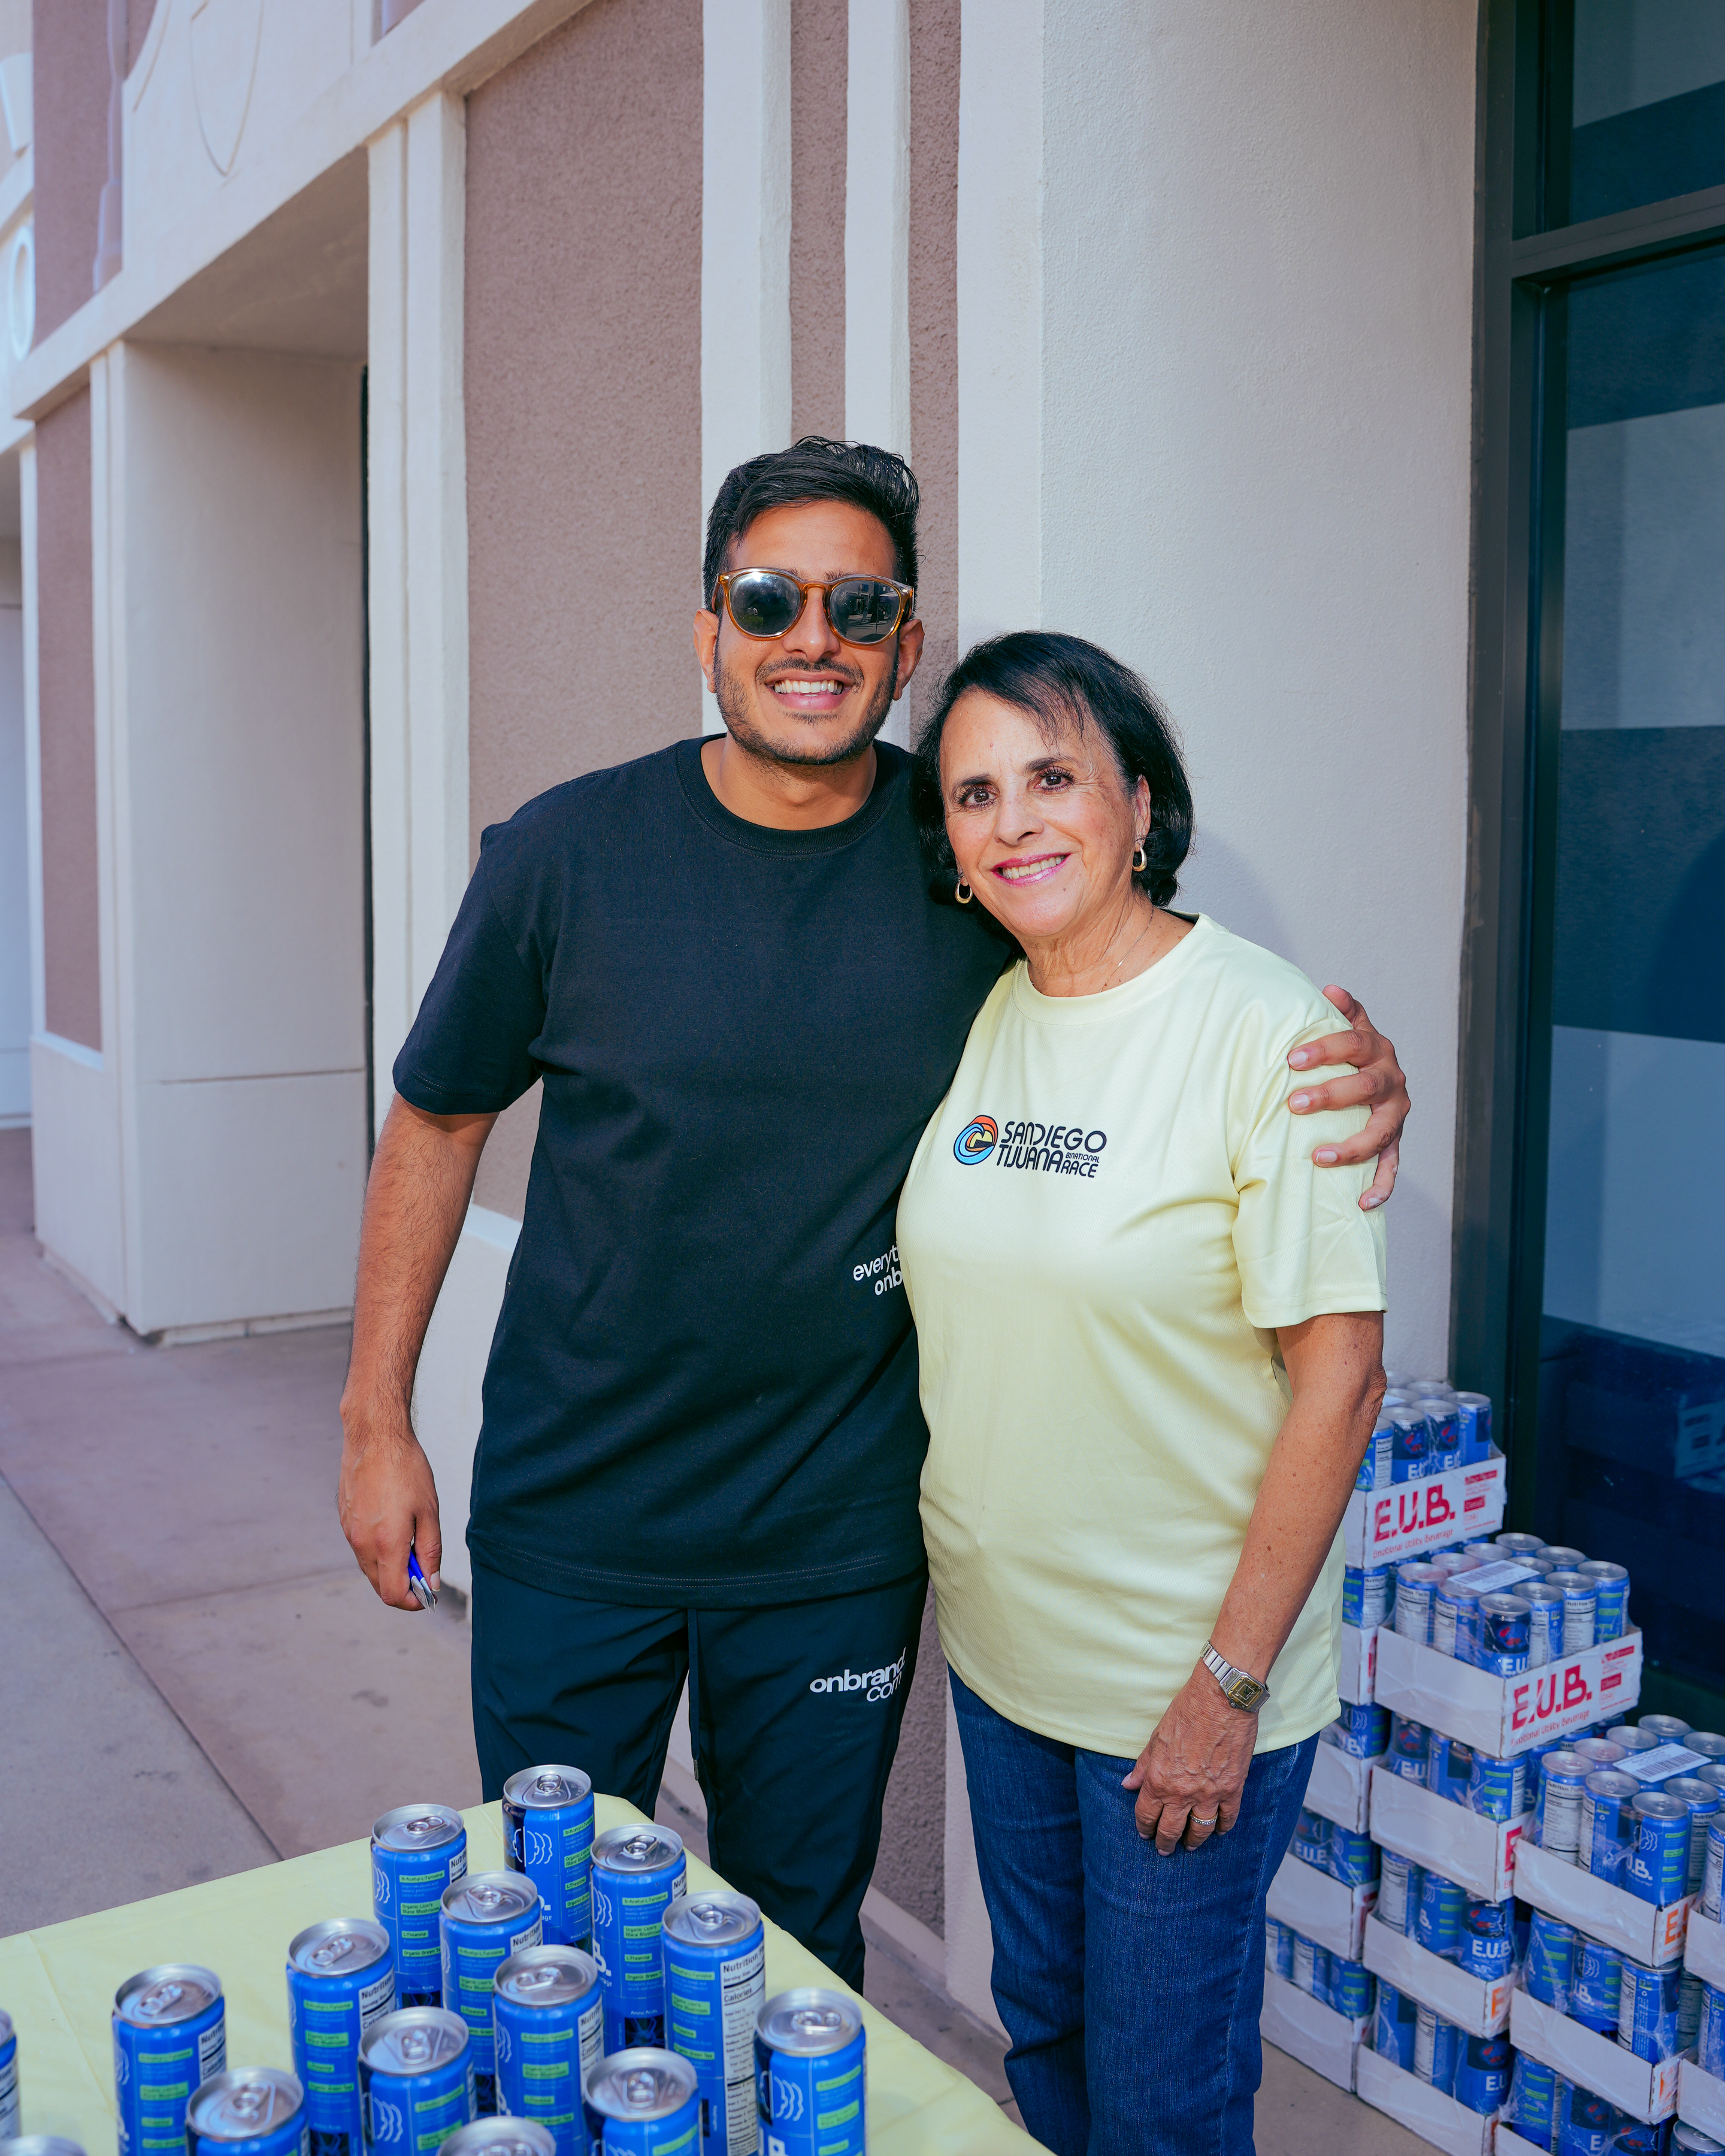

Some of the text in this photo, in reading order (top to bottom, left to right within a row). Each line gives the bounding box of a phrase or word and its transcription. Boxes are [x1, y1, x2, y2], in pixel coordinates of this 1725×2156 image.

[996, 1144, 1098, 1178] TIJUANA RACE
[1066, 1152, 1100, 1163] BINATIONAL
[1373, 1484, 1455, 1543] E.U.B.
[810, 1647, 906, 1693] onbrand
[1512, 1664, 1593, 1731] E.U.B.
[724, 1952, 759, 1973] Nutrition
